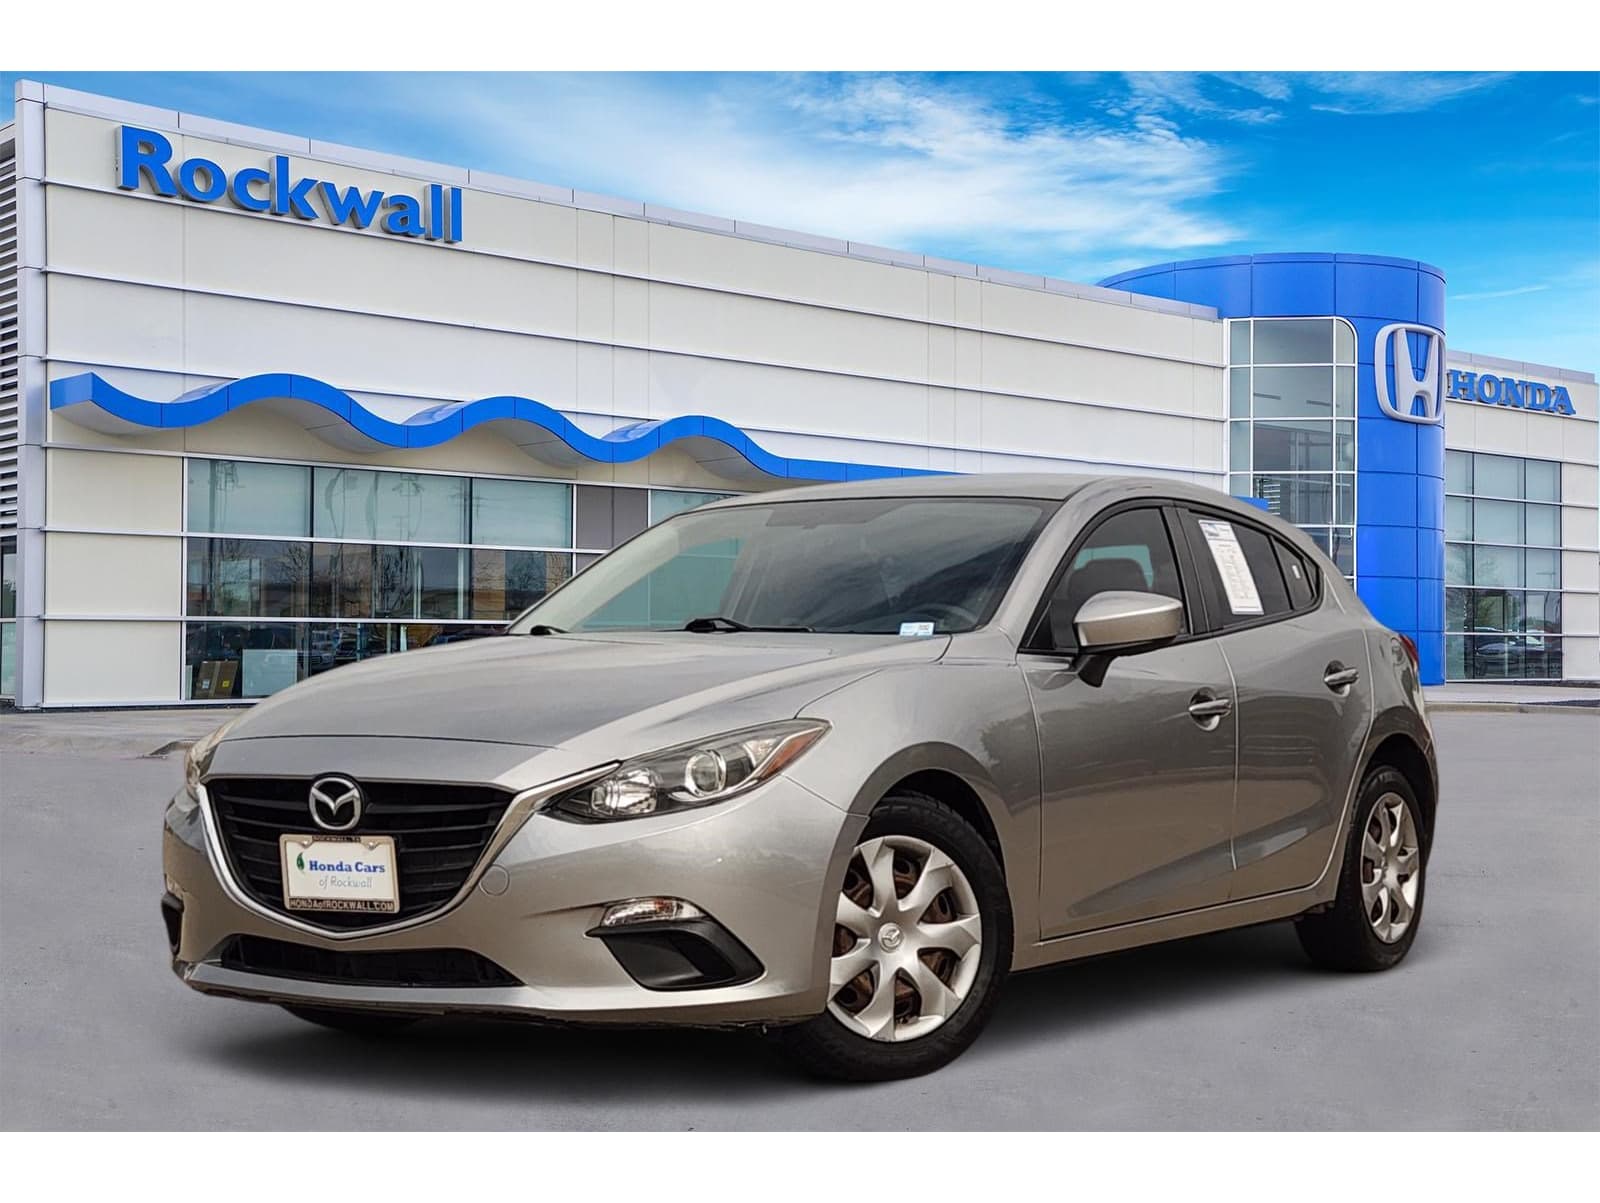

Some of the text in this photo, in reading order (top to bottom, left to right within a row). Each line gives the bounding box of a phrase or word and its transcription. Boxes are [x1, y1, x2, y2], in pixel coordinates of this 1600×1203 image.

[117, 125, 463, 243] Rockwall
[1446, 369, 1576, 415] HONDA
[309, 860, 386, 873] Honda Cars
[319, 875, 373, 890] of Rockwall
